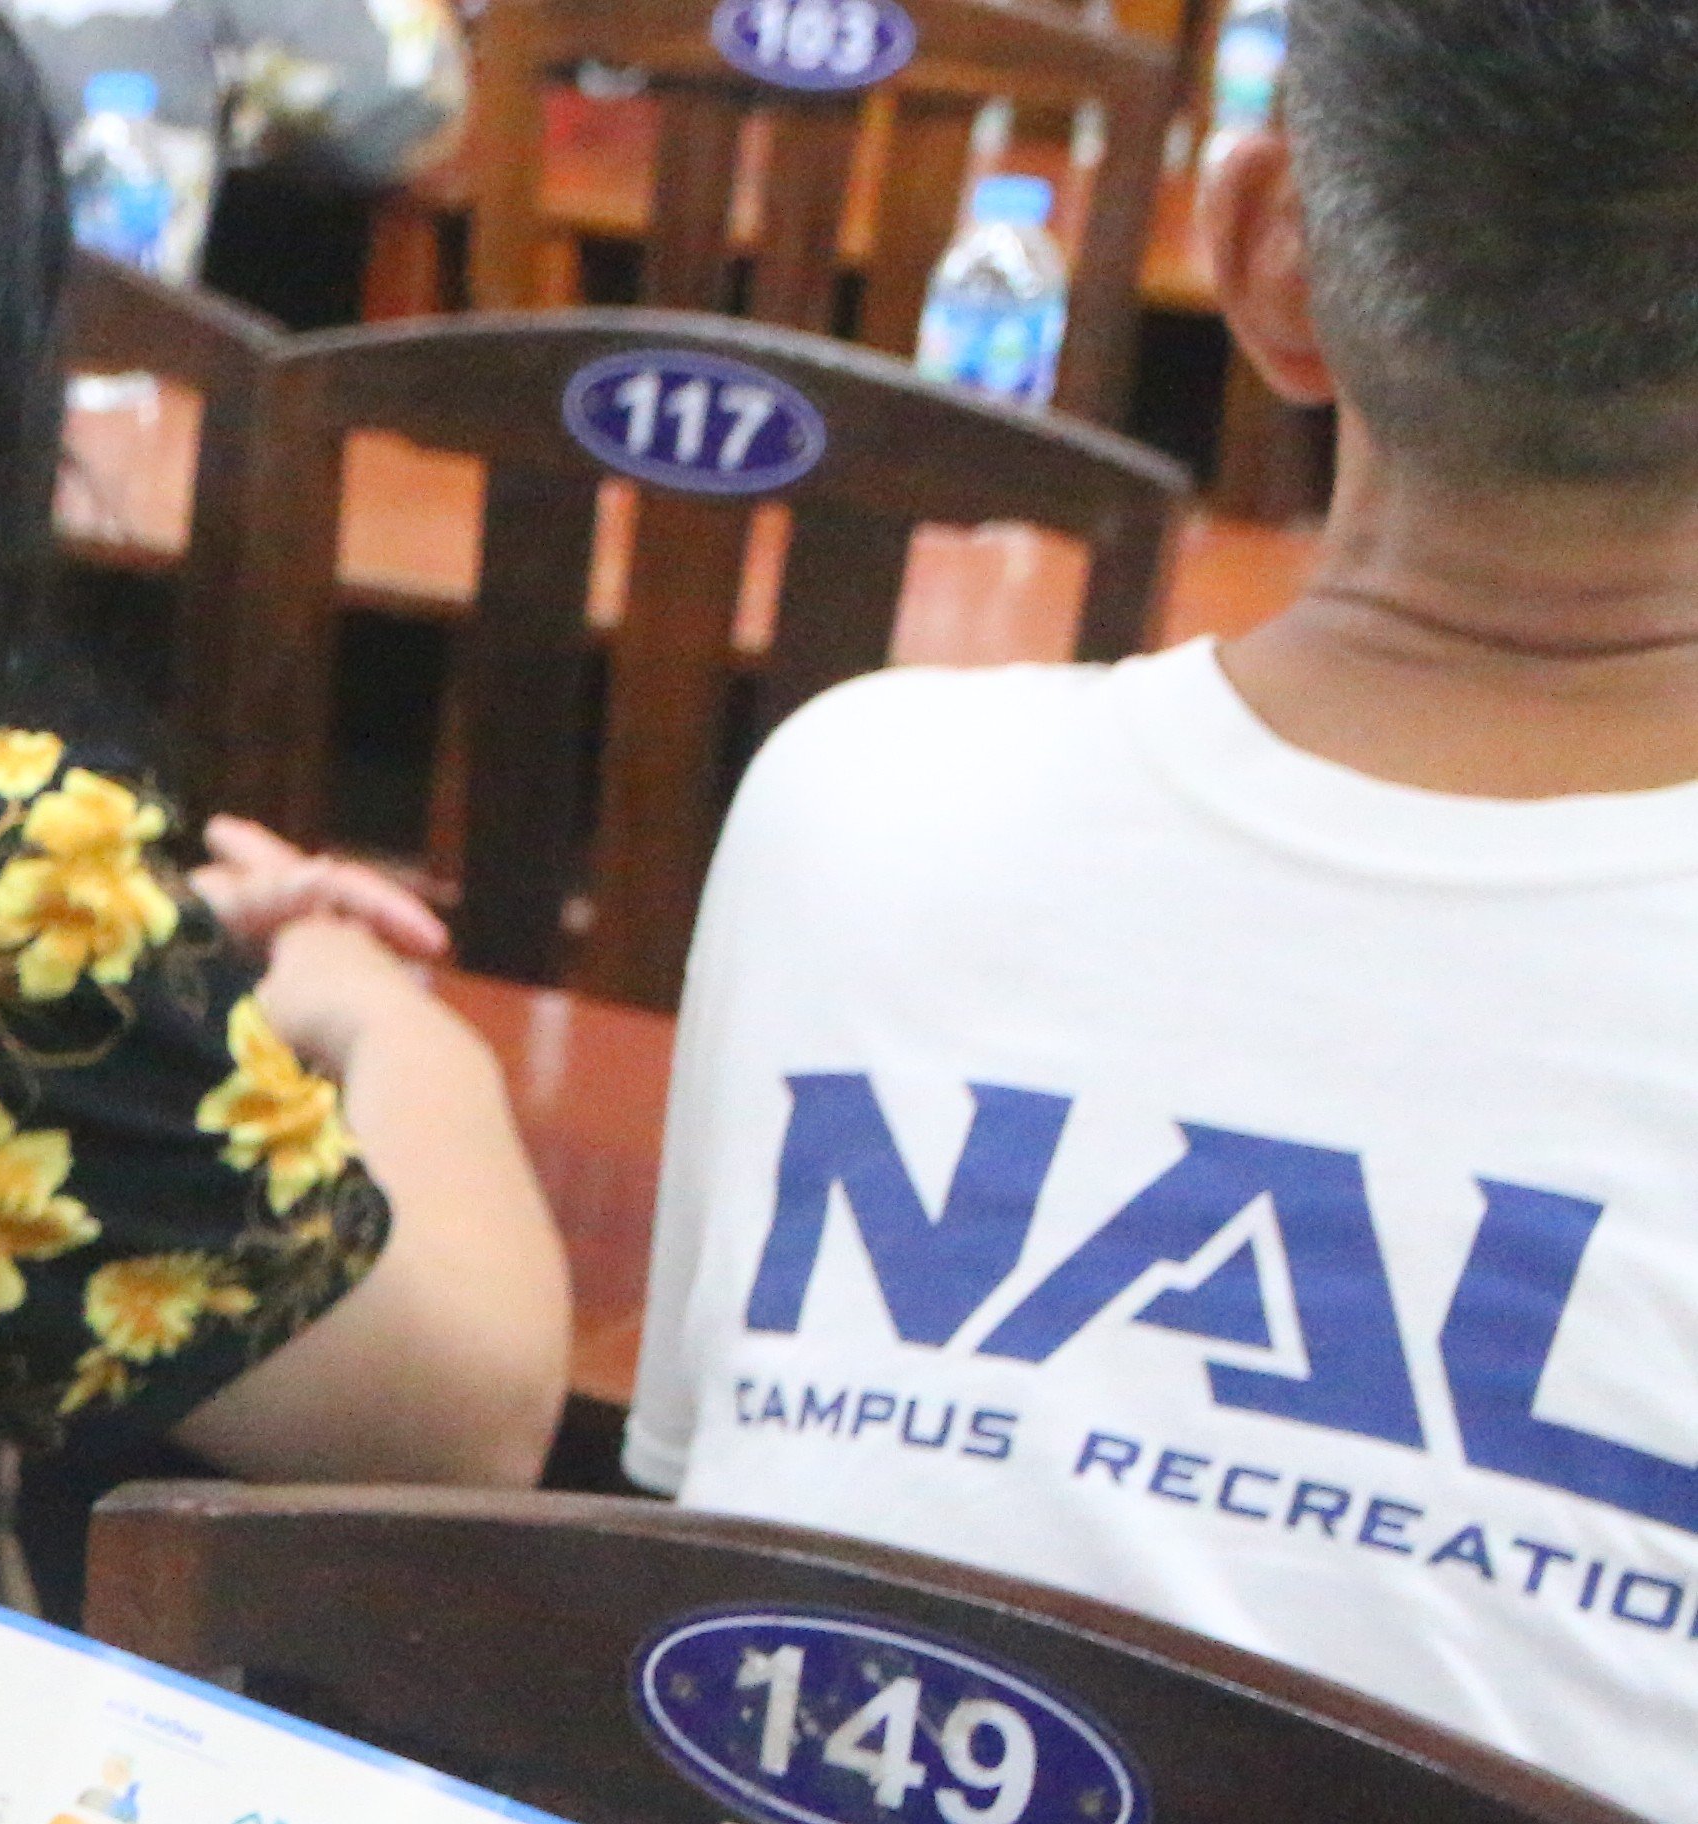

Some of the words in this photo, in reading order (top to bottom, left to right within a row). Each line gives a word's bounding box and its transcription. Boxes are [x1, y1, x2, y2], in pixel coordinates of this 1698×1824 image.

[614, 367, 777, 471] 117
[733, 1376, 1019, 1462] CAMPUS
[1074, 1430, 1698, 1641] RECREATIO
